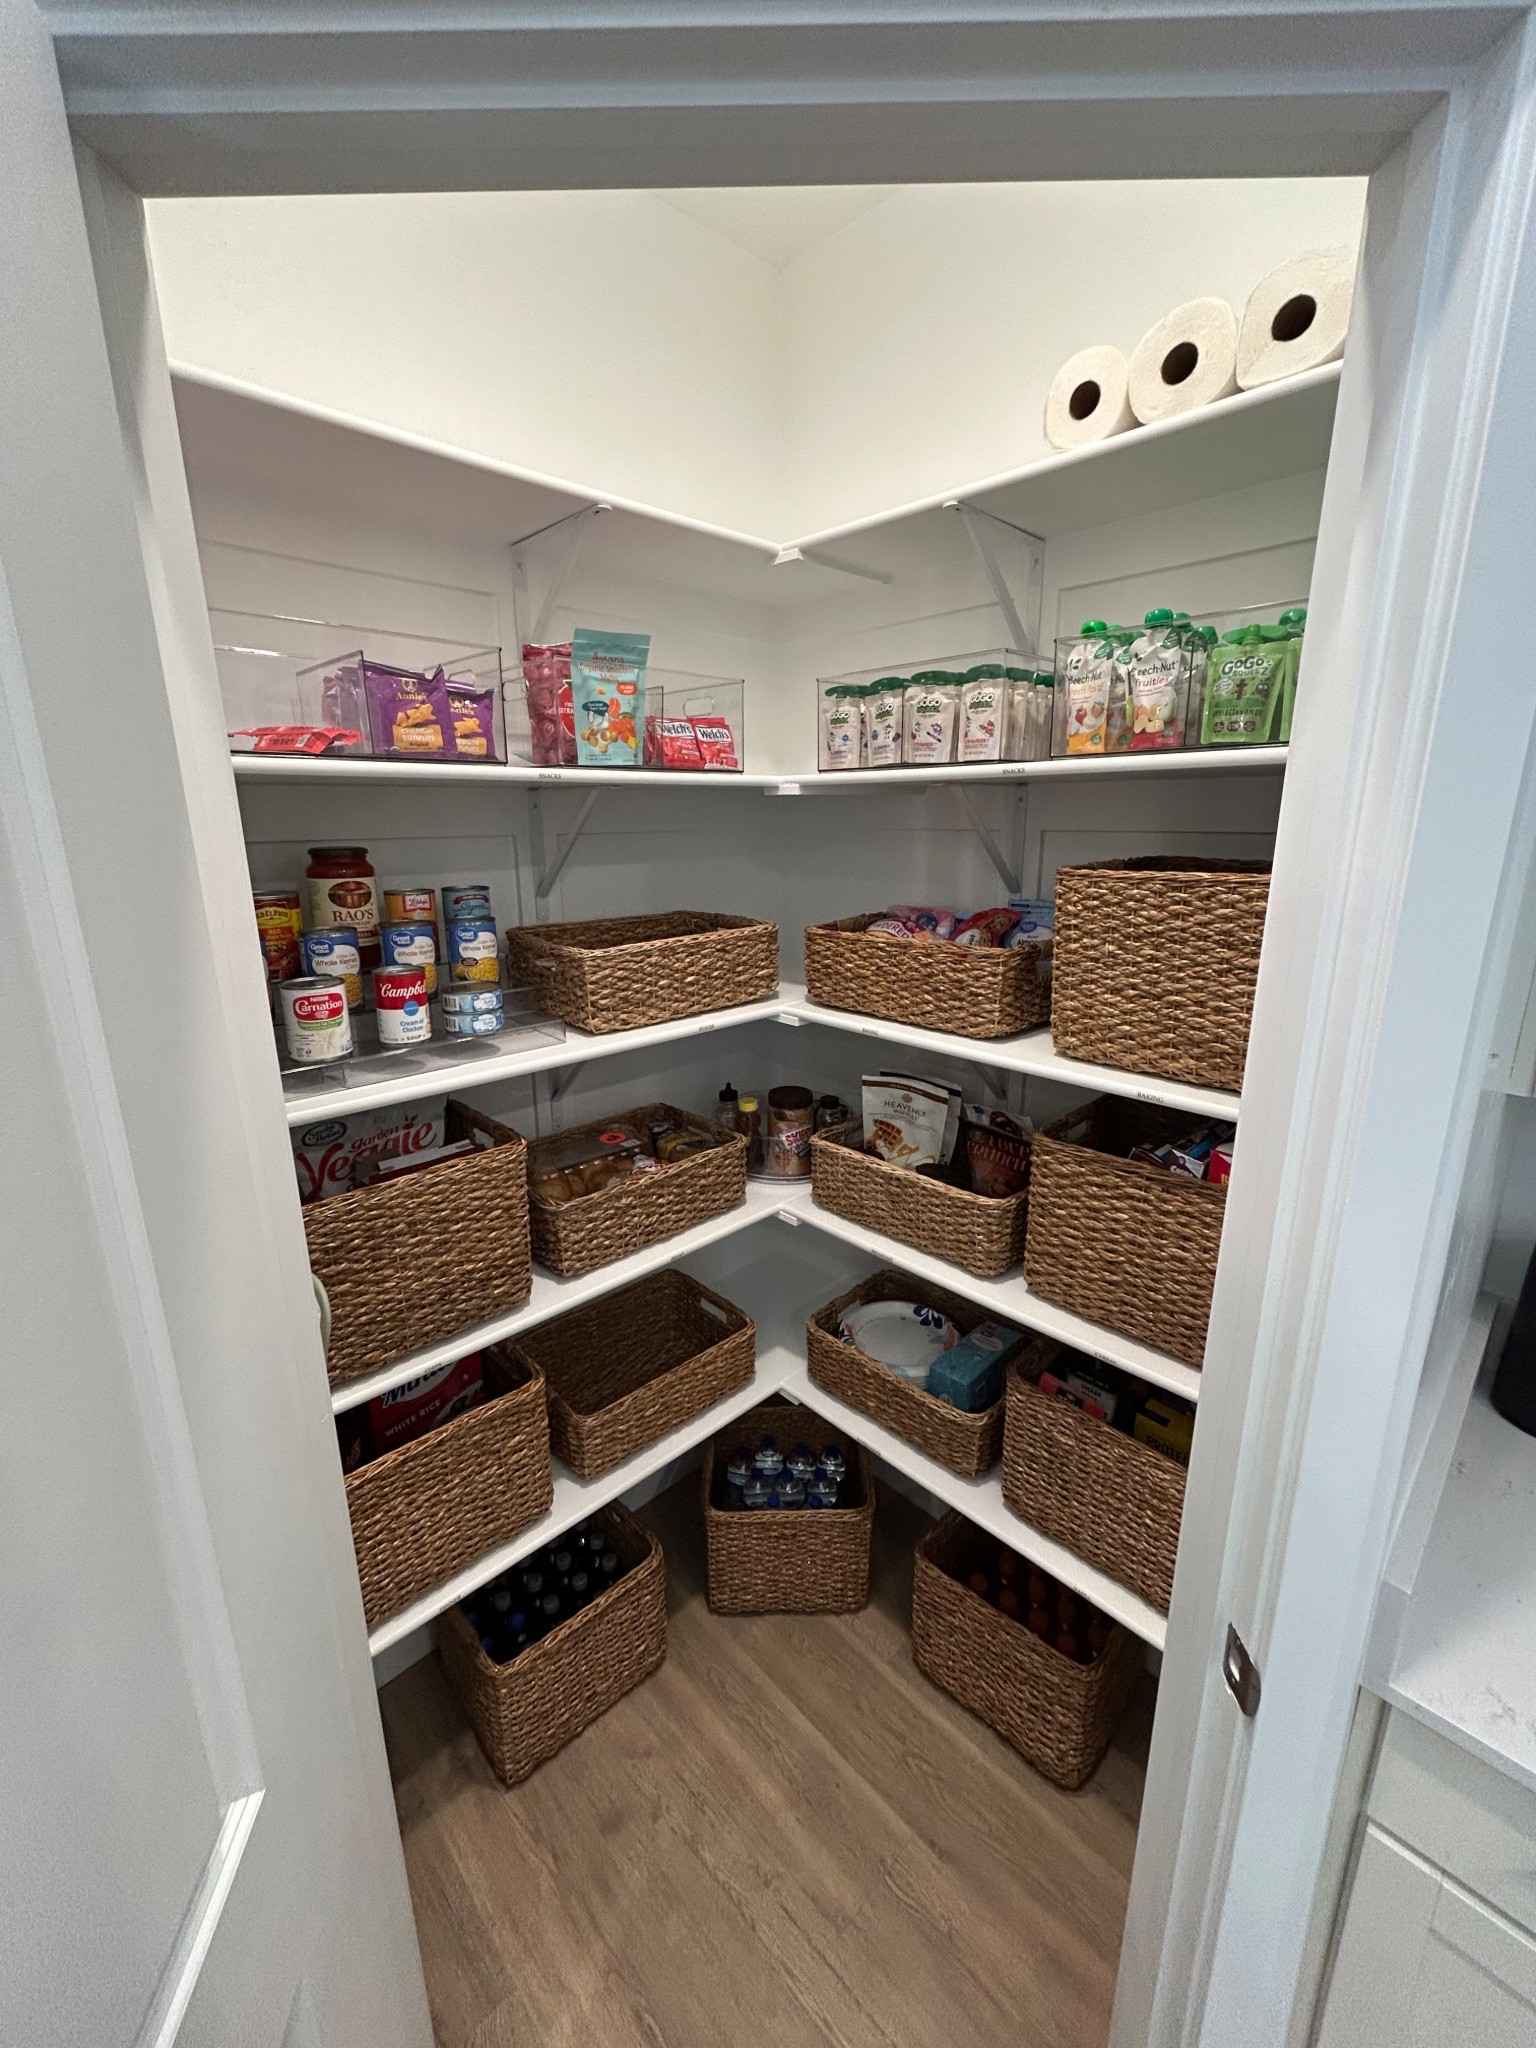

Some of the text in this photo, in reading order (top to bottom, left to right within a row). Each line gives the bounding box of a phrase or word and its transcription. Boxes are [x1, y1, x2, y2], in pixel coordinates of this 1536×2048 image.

[592, 652, 624, 663] Amara
[1135, 676, 1170, 687] fruities
[450, 707, 475, 715] nnie's
[660, 722, 692, 735] Welch's
[698, 728, 730, 740] Welch's
[332, 908, 374, 921] RAO'S
[873, 921, 910, 938] WDERED
[295, 1000, 343, 1015] Carnation
[1137, 1092, 1164, 1103] BAKING
[884, 1101, 927, 1117] HEAVENLY
[348, 1126, 399, 1153] garden
[384, 1398, 442, 1438] WHITE RICE
[1146, 1435, 1190, 1467] PROTEI
